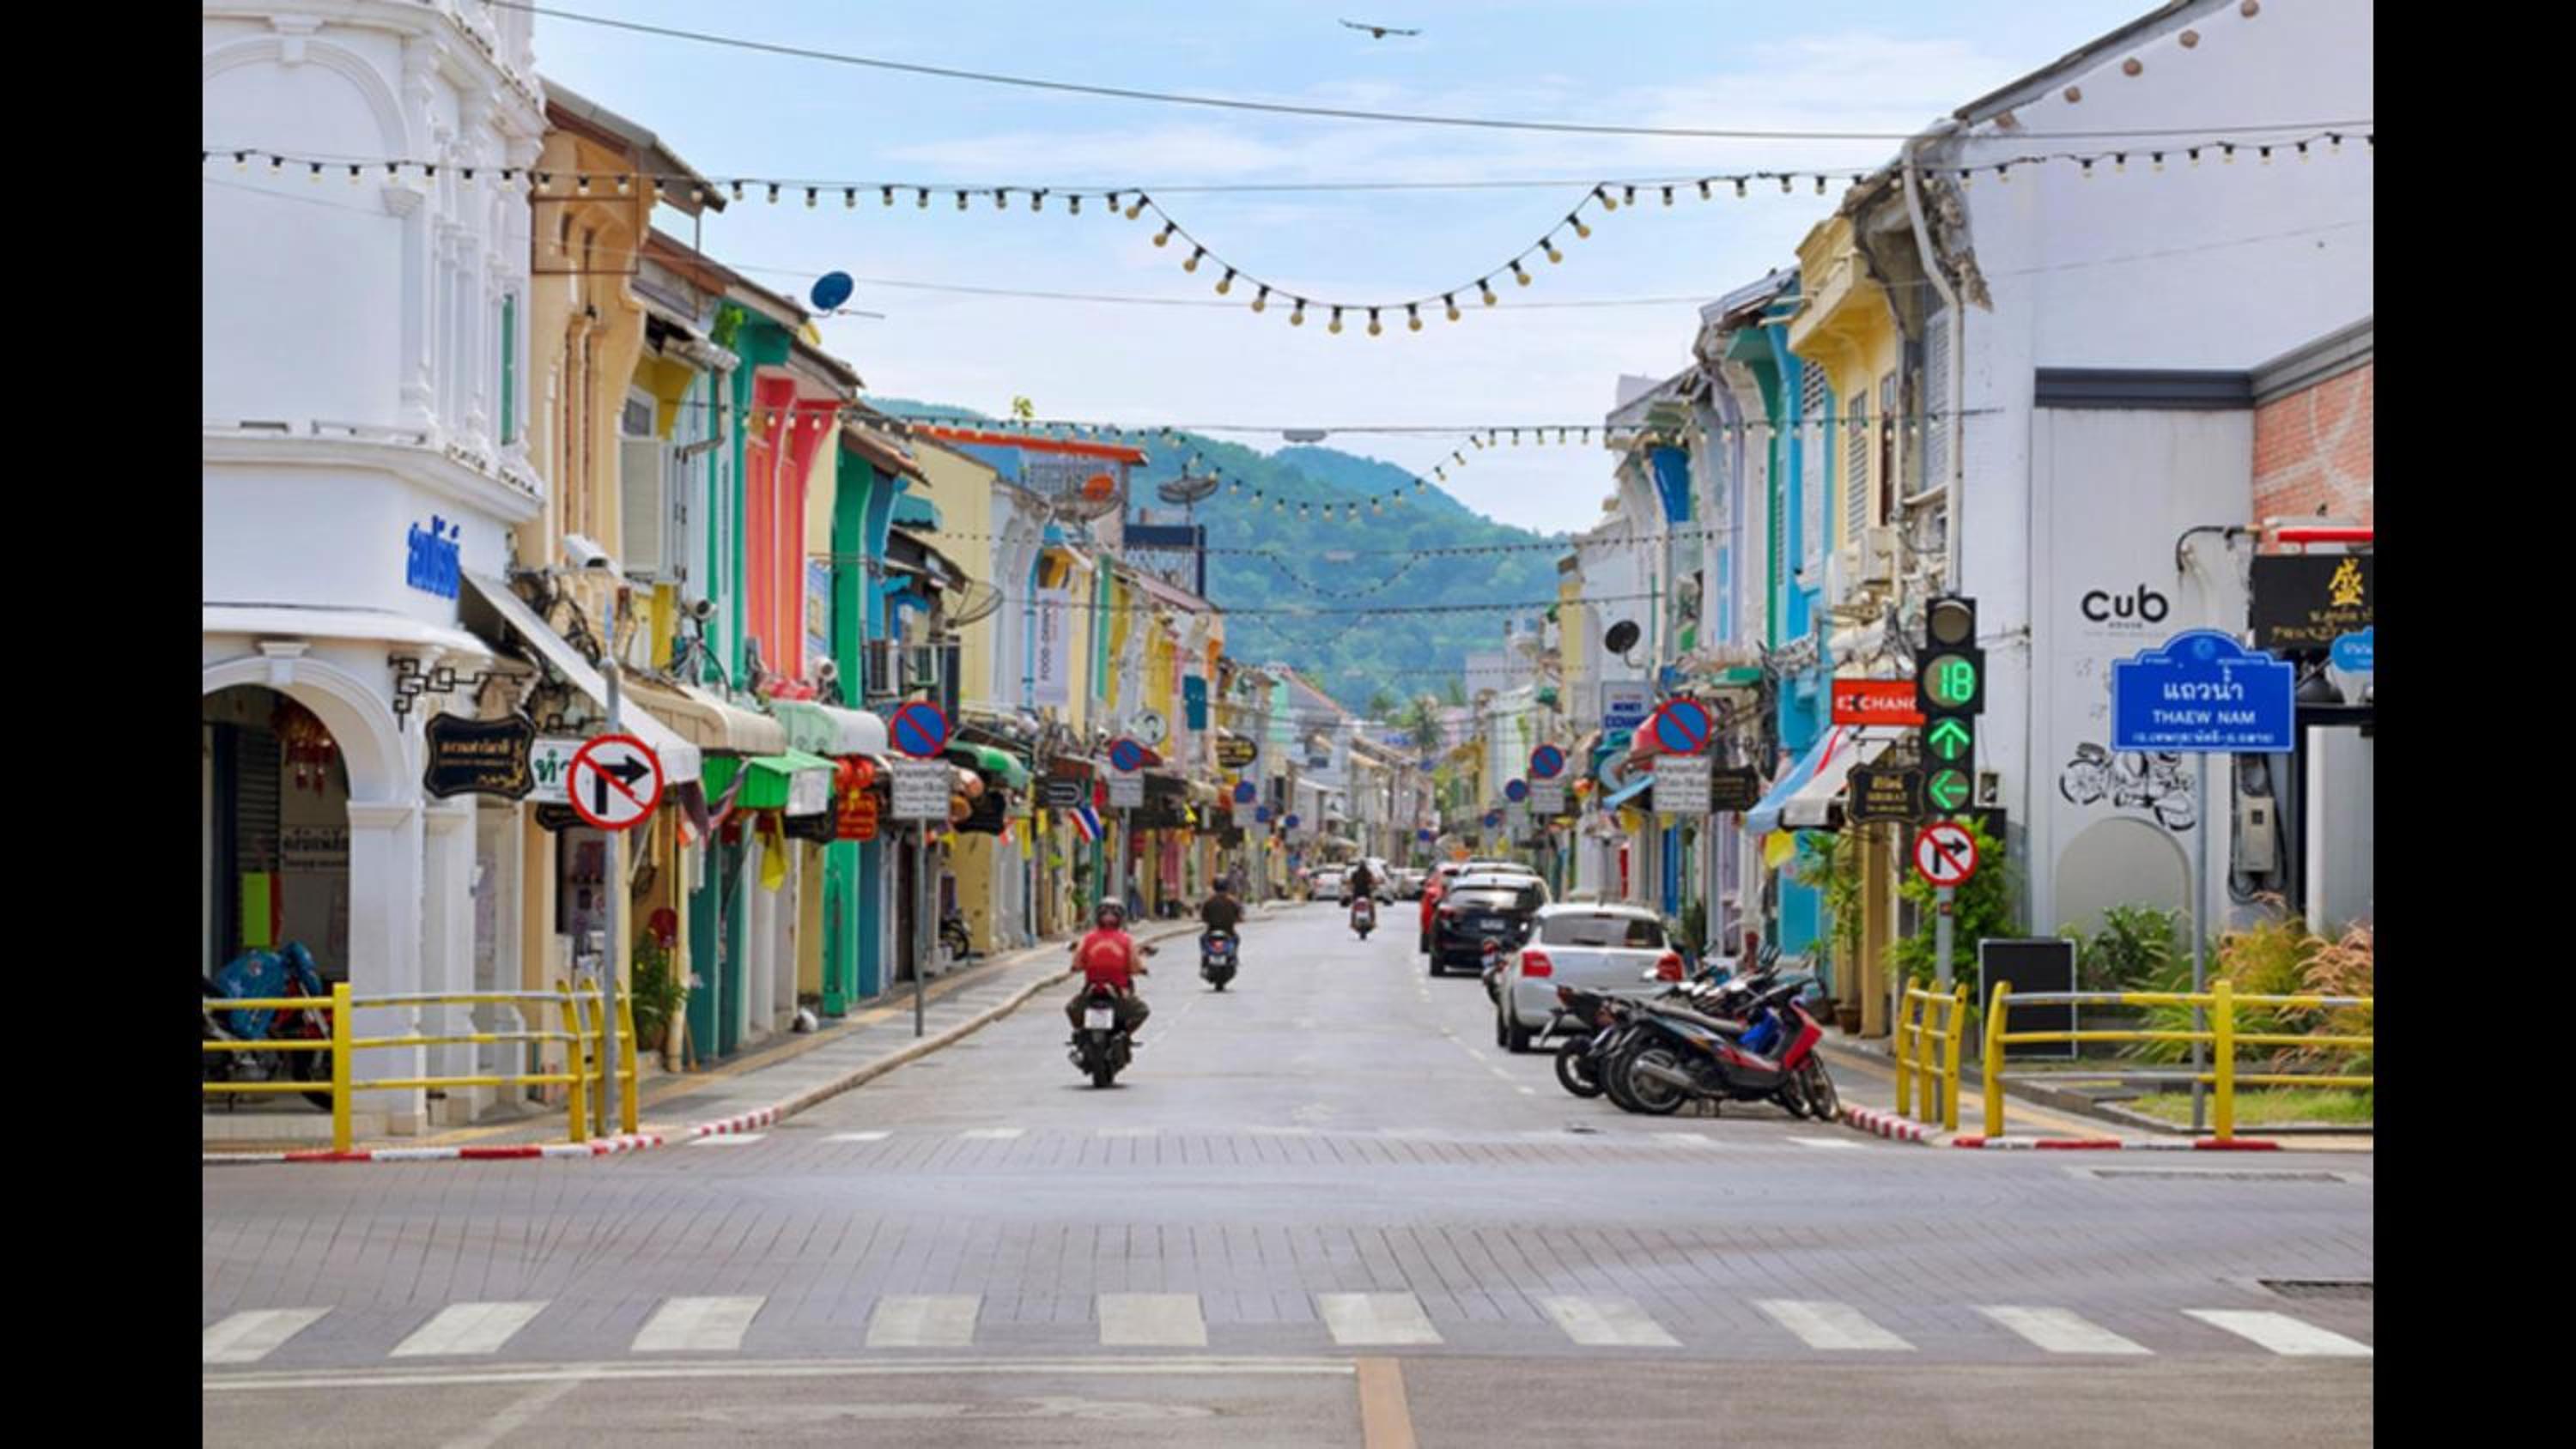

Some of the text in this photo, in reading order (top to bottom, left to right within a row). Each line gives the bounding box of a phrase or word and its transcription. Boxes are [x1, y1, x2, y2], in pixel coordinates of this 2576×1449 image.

[2328, 558, 2364, 607] 盛
[1941, 661, 1975, 703] 18
[2163, 667, 2245, 700] แถวน้ำ
[2153, 709, 2257, 725] THAEW NAM
